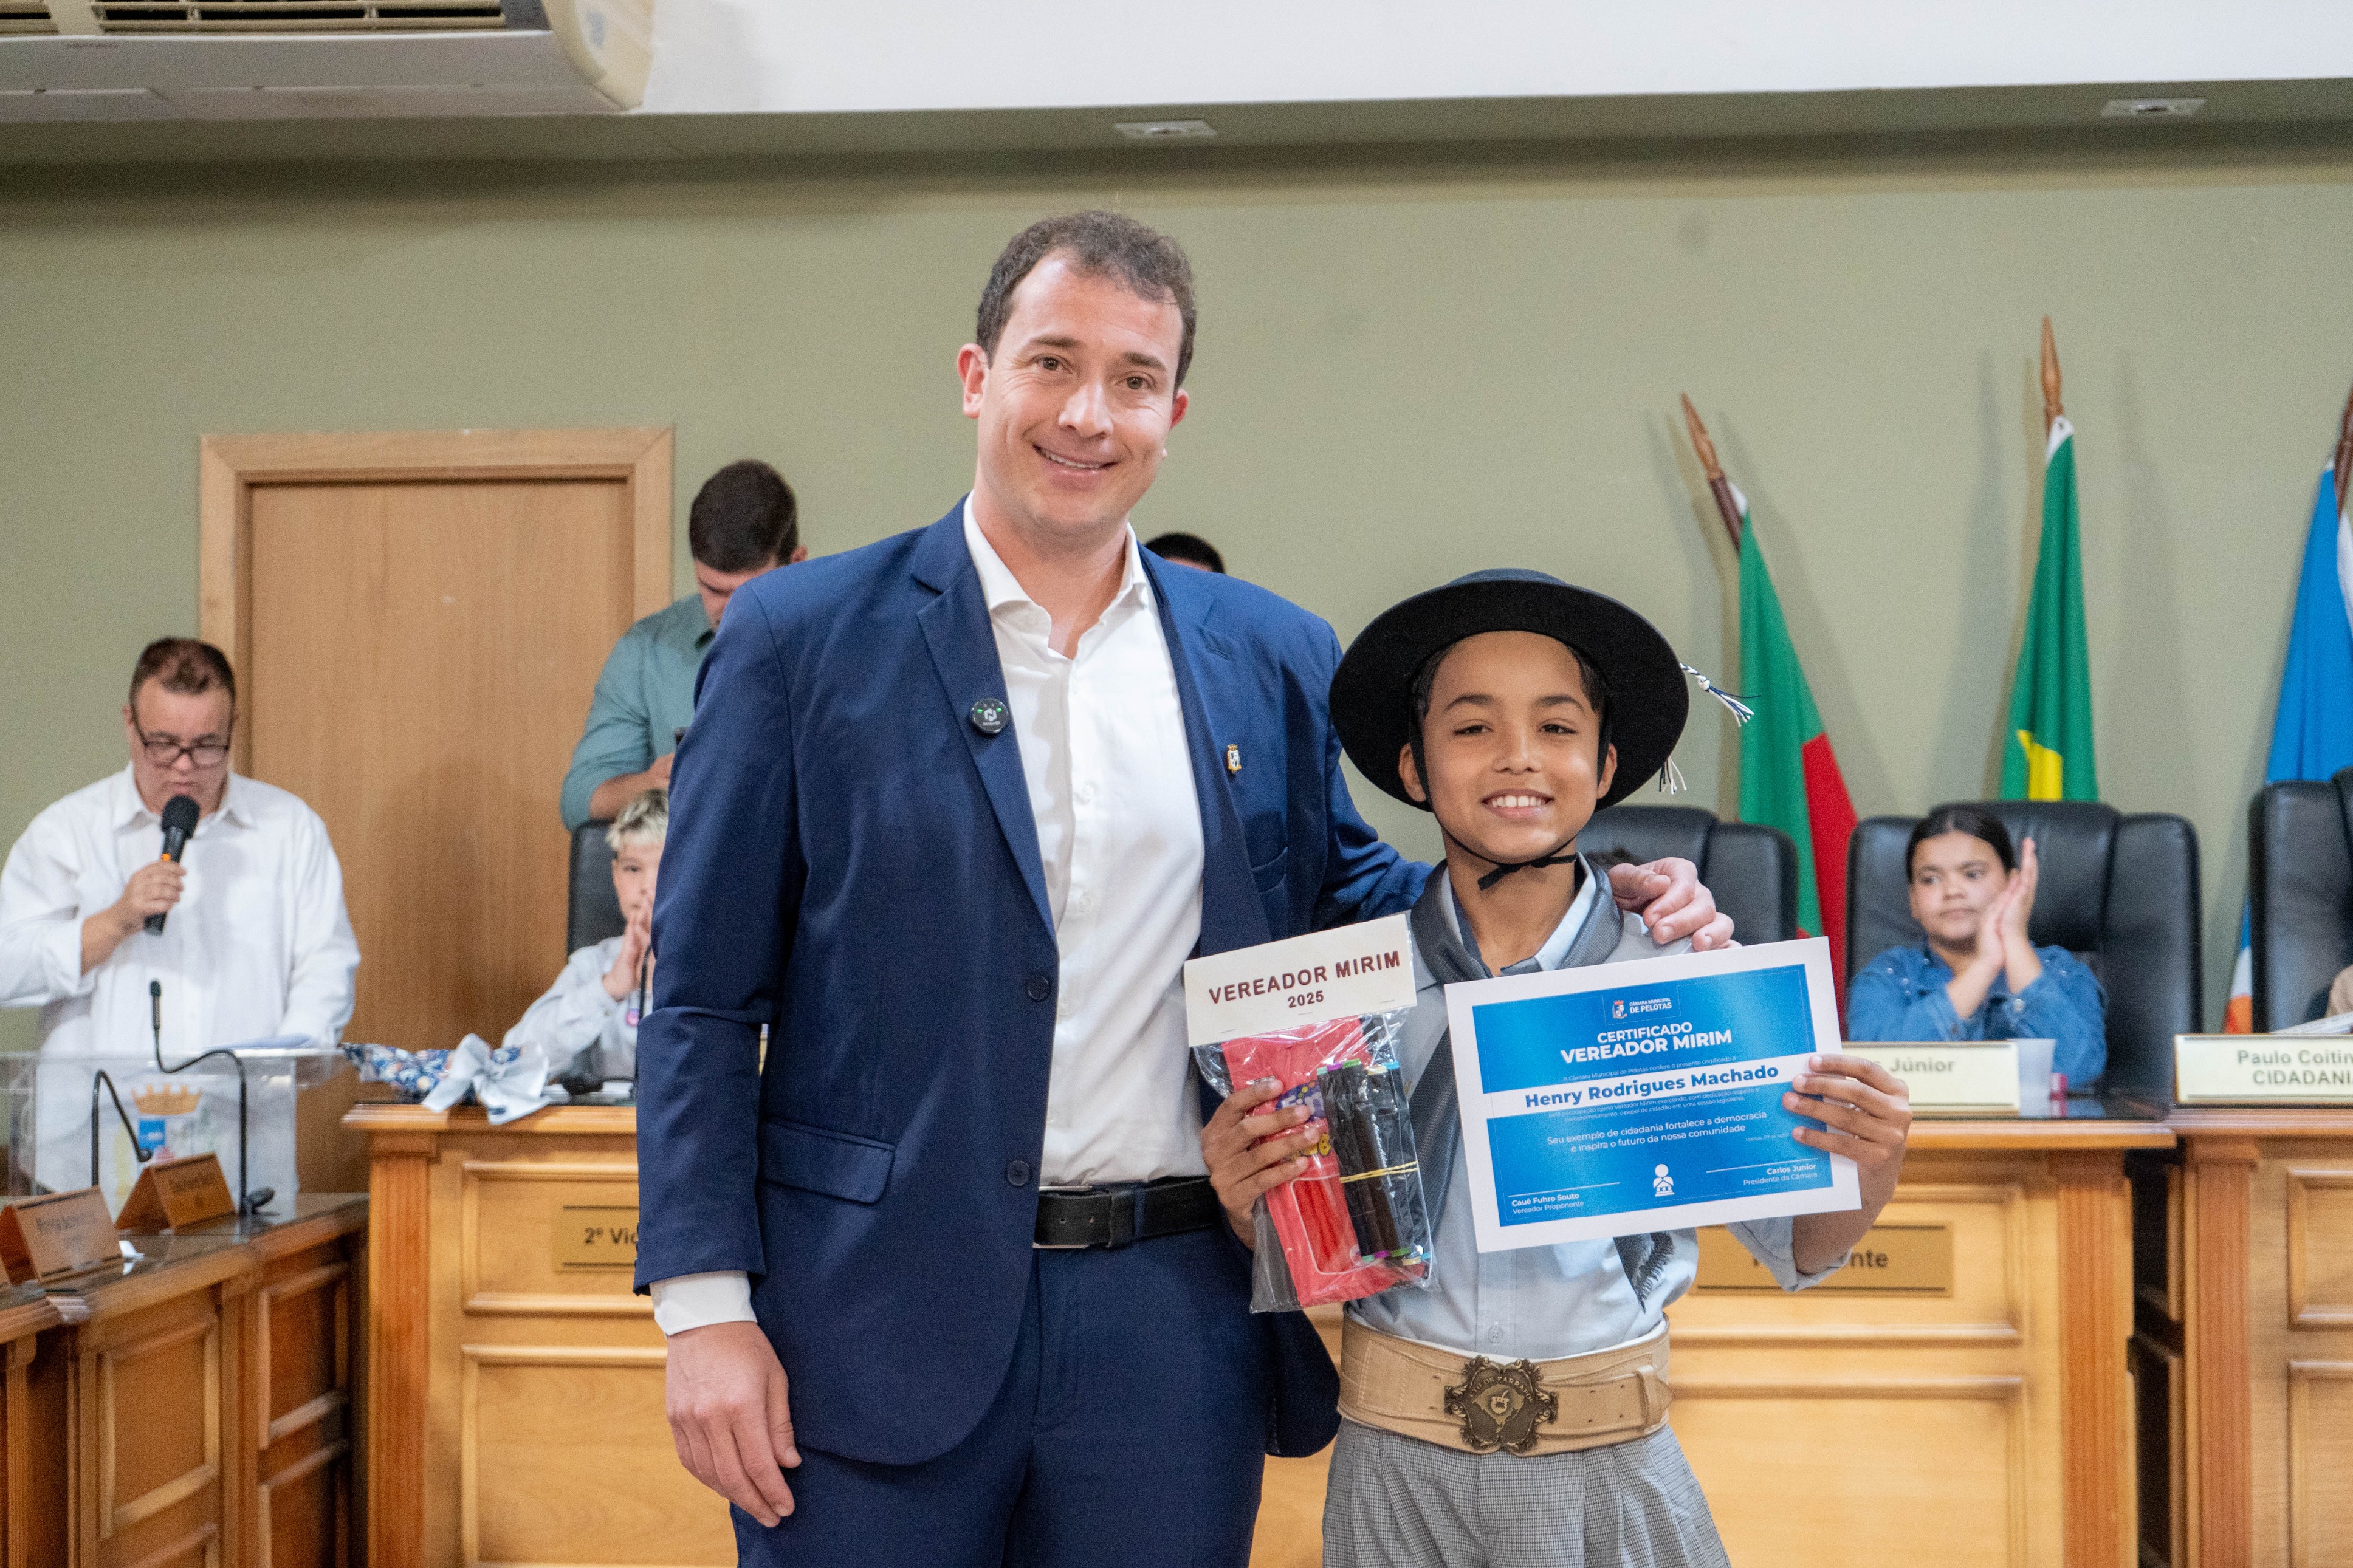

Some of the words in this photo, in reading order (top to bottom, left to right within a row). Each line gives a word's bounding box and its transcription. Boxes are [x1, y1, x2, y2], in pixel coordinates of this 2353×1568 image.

[1208, 965, 1328, 1004] VEREADOR
[1335, 950, 1400, 978] MIRIM
[1288, 990, 1324, 1008] 2025
[1641, 1002, 1672, 1012] PELOTAS
[1597, 1022, 1692, 1044] CERTIFICADO
[1560, 1038, 1668, 1064] VEREADOR
[1673, 1029, 1732, 1050] MIRIM
[1891, 1056, 1955, 1072] Júnior
[2236, 1049, 2292, 1064] Paulo
[1591, 1070, 1620, 1078] Municipal
[2252, 1069, 2353, 1085] CIDADANI
[1525, 1090, 1582, 1108] Henry
[1588, 1078, 1686, 1100] Rodrigues
[1691, 1065, 1779, 1086] Machado
[1624, 1107, 1640, 1115] papel
[1547, 1137, 1564, 1145] Seu
[1566, 1131, 1605, 1143] exemplo
[1607, 1129, 1619, 1138] de
[1620, 1123, 1664, 1136] cidadania
[1665, 1119, 1705, 1130] fortalece
[1714, 1111, 1767, 1124] democracia
[1579, 1141, 1609, 1152] inspira
[1618, 1137, 1646, 1147] futuro
[1647, 1134, 1659, 1143] da
[1661, 1132, 1686, 1142] nossa
[1688, 1124, 1746, 1138] comunidade
[1767, 1166, 1791, 1175] Carlos
[1792, 1163, 1816, 1171] Junior
[1743, 1175, 1780, 1185] Presidente
[1791, 1171, 1818, 1180] Câmara
[1511, 1198, 1531, 1207] Cauê
[1557, 1193, 1580, 1201] Souto
[1513, 1205, 1543, 1214] Vereador
[1544, 1200, 1584, 1210] Proponente
